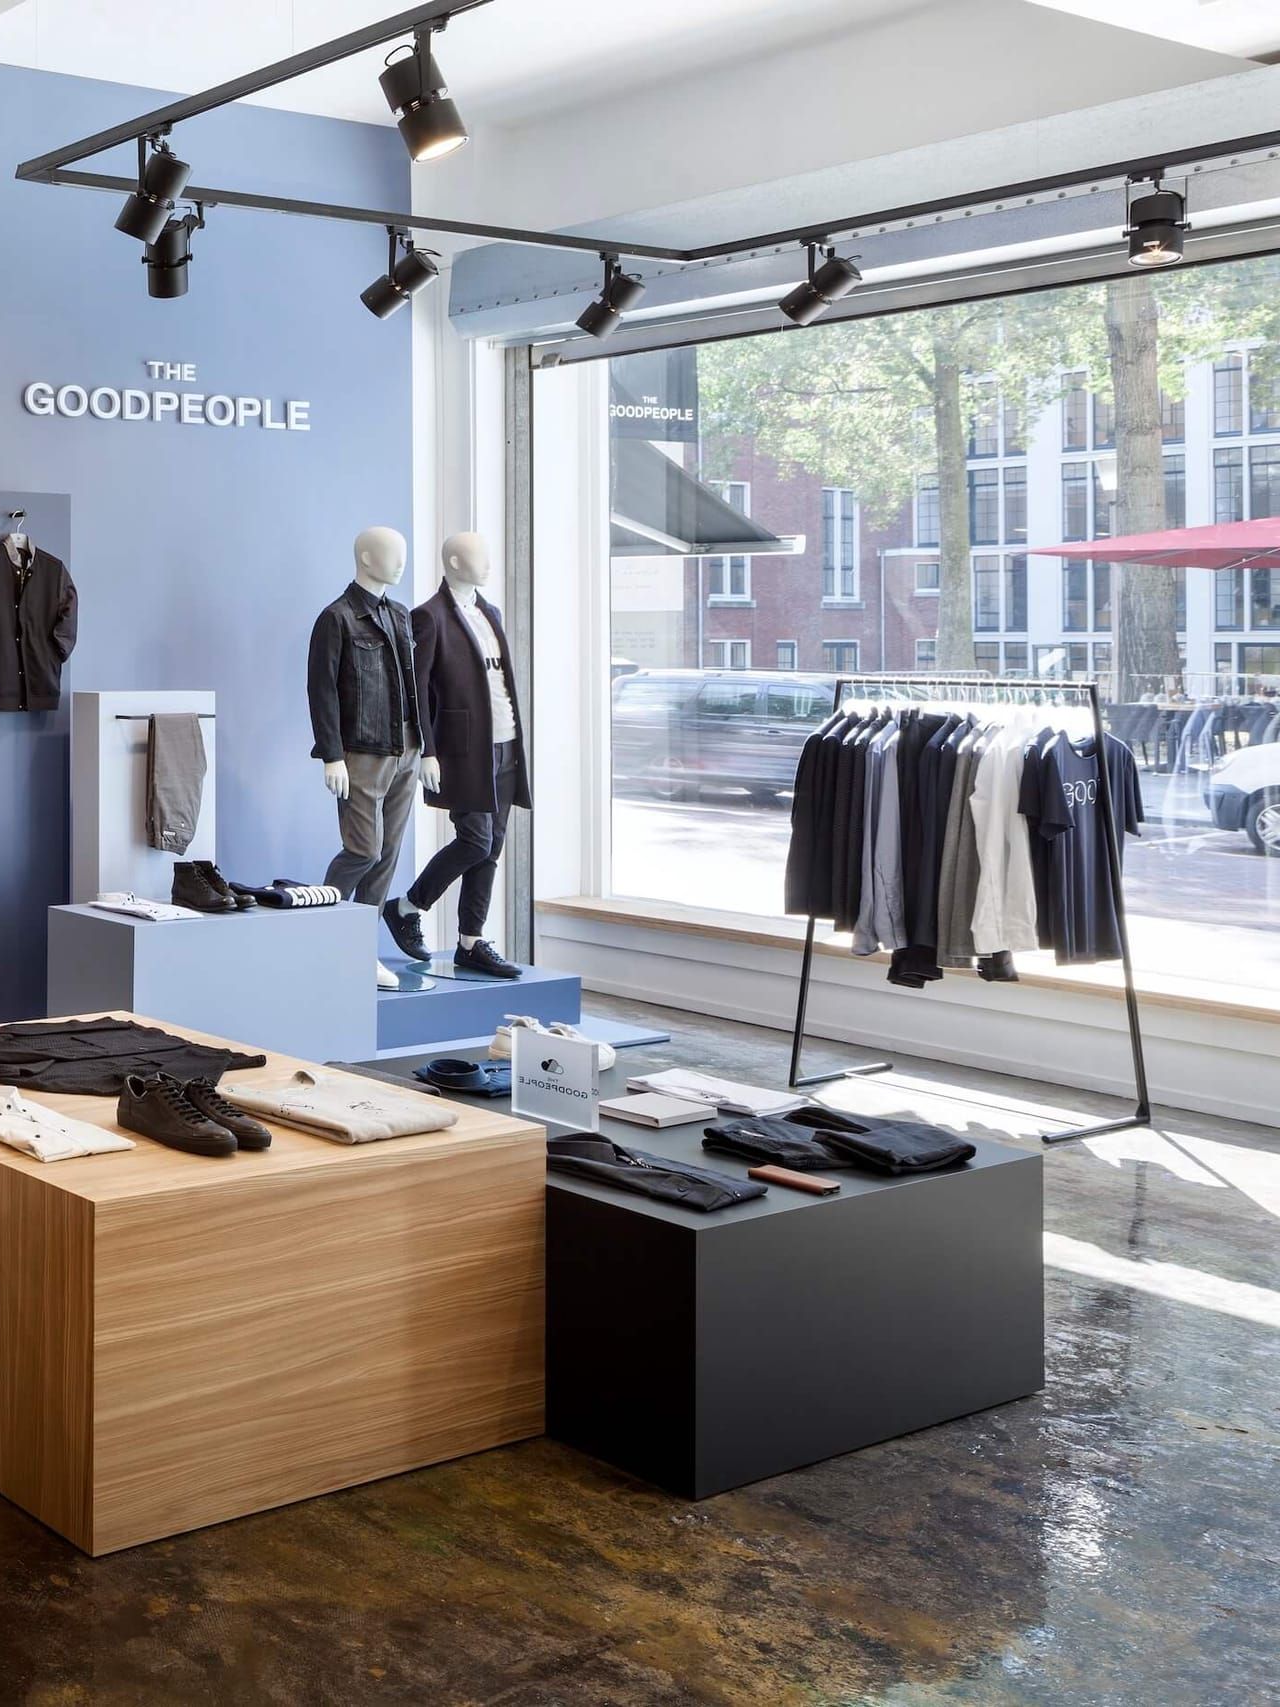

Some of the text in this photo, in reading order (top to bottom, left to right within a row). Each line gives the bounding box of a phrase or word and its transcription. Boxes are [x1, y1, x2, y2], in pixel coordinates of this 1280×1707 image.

[146, 360, 197, 382] THE
[23, 382, 311, 431] GOODPEOPLE
[642, 396, 658, 404] THE
